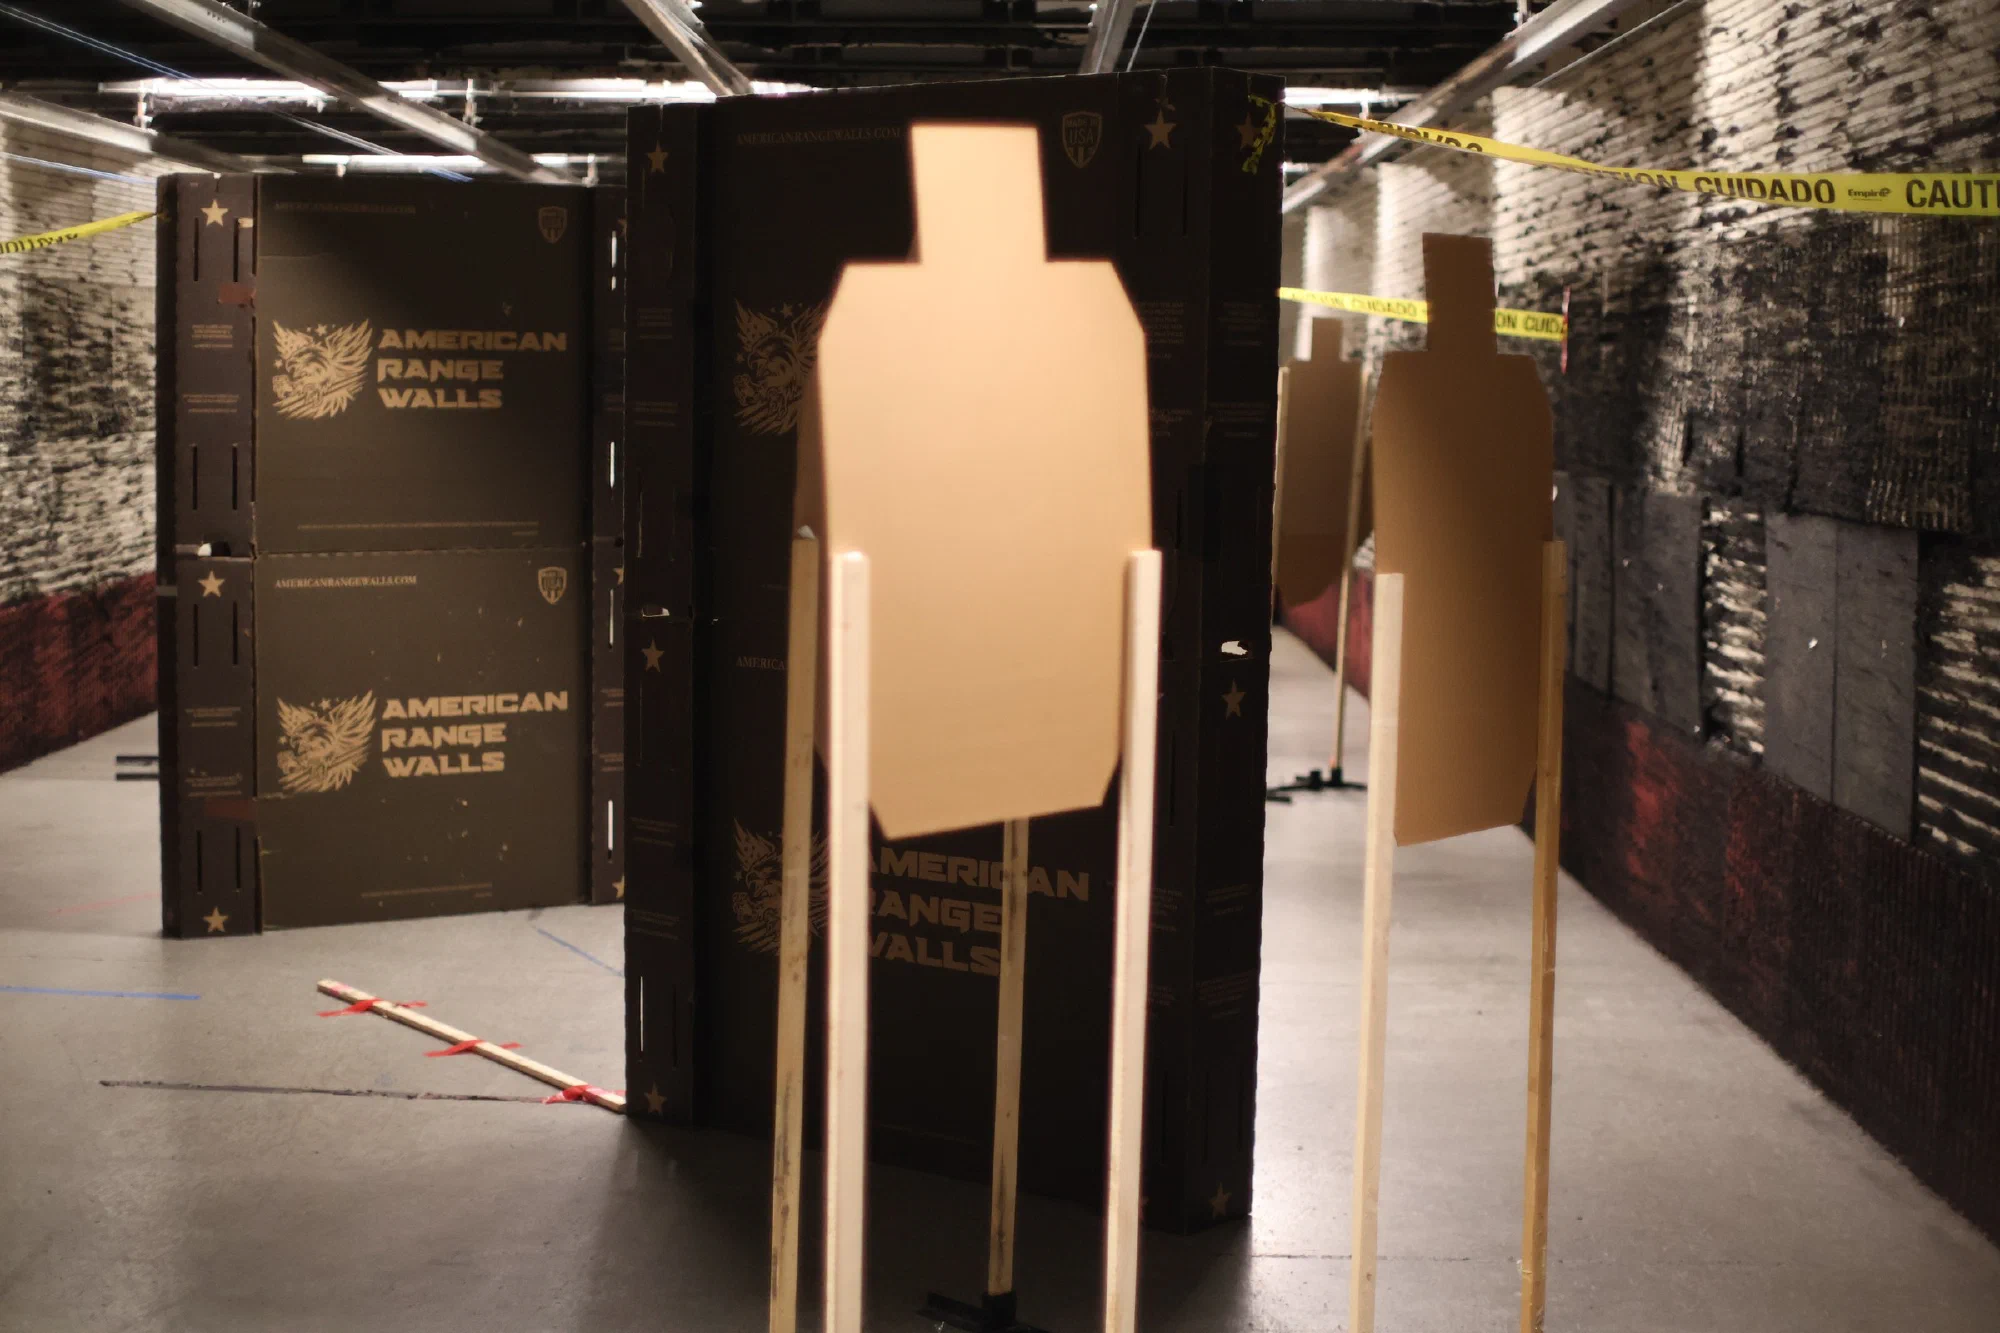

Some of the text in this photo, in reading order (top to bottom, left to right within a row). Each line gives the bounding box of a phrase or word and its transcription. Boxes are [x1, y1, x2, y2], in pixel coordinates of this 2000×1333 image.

[1068, 127, 1094, 145] USA
[1694, 176, 1835, 204] CUIDADO
[378, 328, 567, 352] AMERICAN
[377, 357, 504, 383] RANGE
[377, 387, 503, 410] WALLS
[274, 575, 417, 589] AMERICANRANGEWALLS.COM
[382, 691, 569, 720] AMERICAN
[381, 721, 508, 753] RANGE
[382, 751, 506, 778] WALLS
[871, 887, 1002, 935] ANGE
